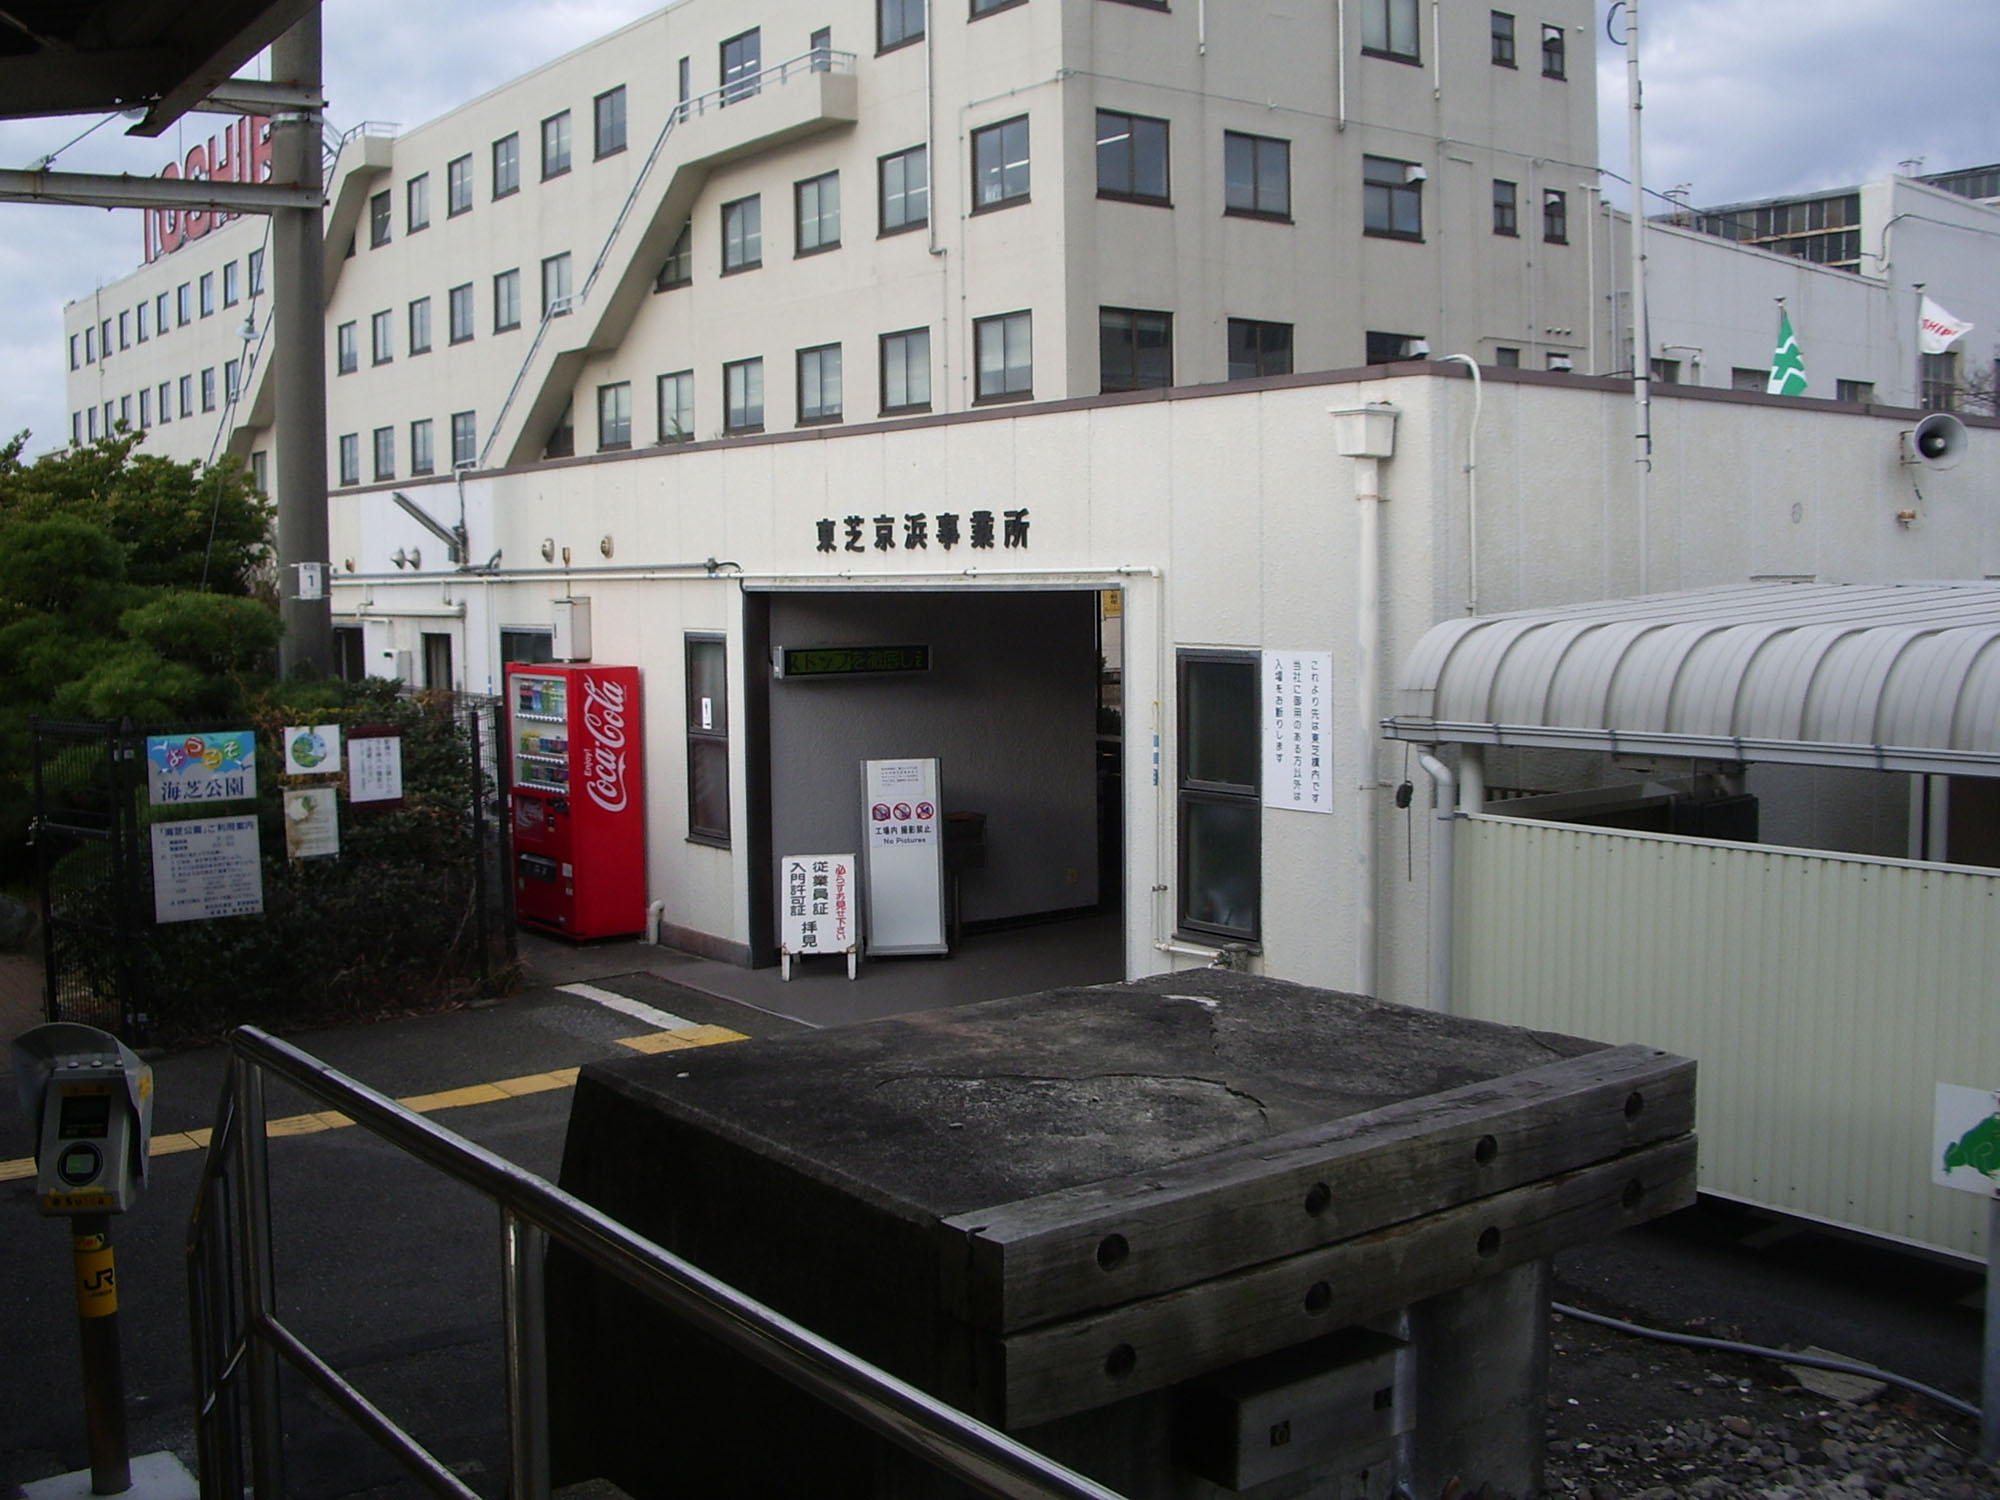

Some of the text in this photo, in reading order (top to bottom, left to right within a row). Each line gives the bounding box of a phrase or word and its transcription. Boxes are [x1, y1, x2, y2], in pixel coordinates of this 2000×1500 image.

[815, 507, 1030, 554] 東芝京浜事業所
[308, 574, 314, 588] 1
[168, 737, 242, 767] ようこそ
[584, 673, 627, 812] Coca-Cola
[161, 777, 244, 801] 海芝公園
[875, 825, 932, 836] 工場内 撮影禁止
[896, 837, 926, 845] Pictures
[790, 862, 807, 917] 入門許可証
[812, 861, 829, 916] 従業員証
[801, 920, 818, 948] 拝見
[84, 1267, 114, 1290] JR
